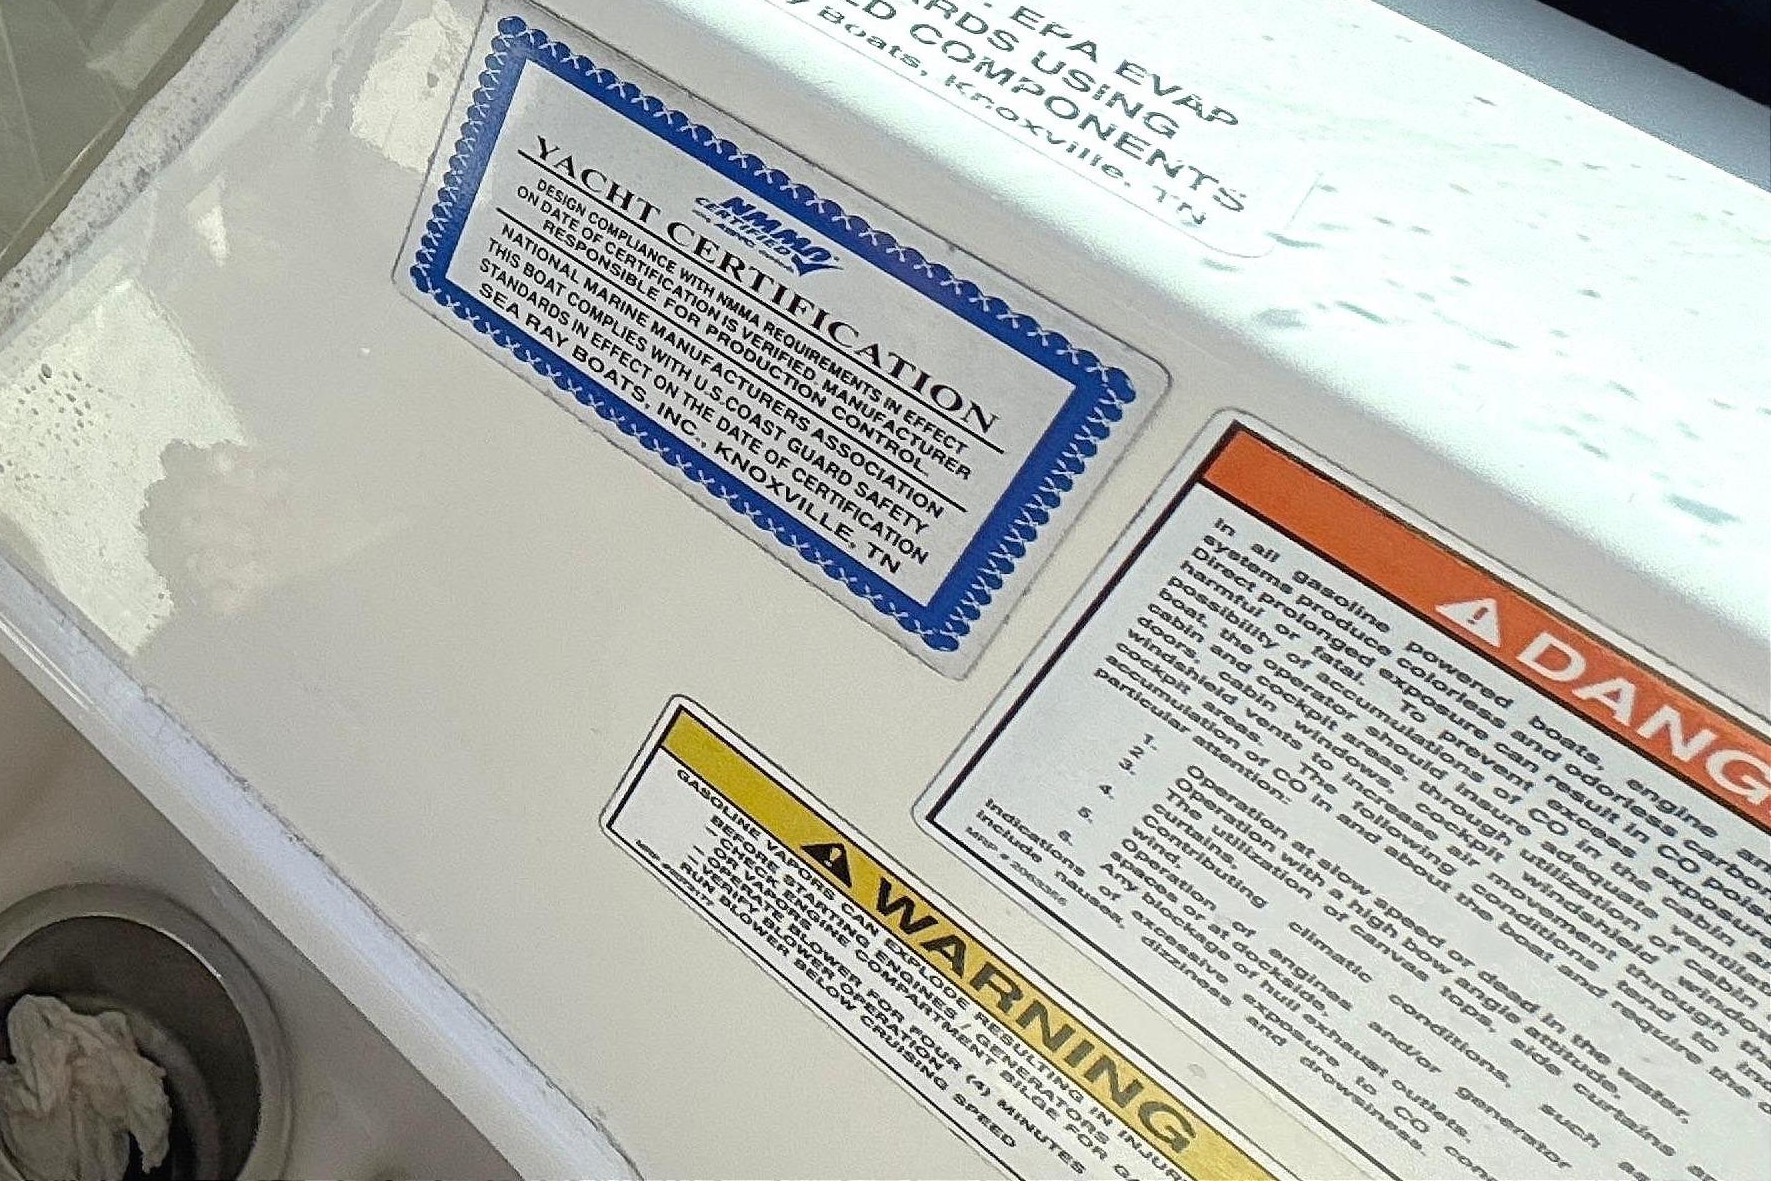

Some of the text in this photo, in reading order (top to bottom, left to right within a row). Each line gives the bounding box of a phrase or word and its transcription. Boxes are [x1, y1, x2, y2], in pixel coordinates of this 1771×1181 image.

[909, 23, 1247, 213] COMPONENTS
[1009, 5, 1097, 63] EPA
[1113, 59, 1239, 126] EVAP
[1031, 50, 1180, 140] USING
[501, 223, 945, 519] NATIONAL MARINE MANUFACTURERS ASSOCIATION
[517, 185, 540, 207] ON
[540, 200, 580, 232] DATE
[581, 227, 604, 243] OF
[604, 241, 721, 322] CERTIFICATION
[721, 315, 739, 333] IS
[822, 378, 972, 480] MANUFACTURER
[537, 135, 1000, 434] YACHT CERTIFICATION
[537, 178, 969, 454] DESIGN COMPLIANCE WITH NMMA REQUIREMENTS IN EFFECT
[542, 219, 660, 302] RESPONSIBLE
[663, 296, 701, 328] FOR
[705, 323, 827, 408] PRODUCTION
[694, 197, 792, 255] CERTIFIED
[479, 258, 929, 565] STANDARDS IN EFFECT ON THE DATE OF CERTIFICATION
[479, 282, 901, 574] SEA RAY BOATS, INC., KNOXVILLE, TN
[488, 237, 930, 535] THIS BOAT COMPLIES WITH U.S.COAST GUARD SAFETY
[1179, 560, 1637, 859] harmful or fatal. To prevent excess
[1191, 546, 1701, 874] Direct prolonged exposure can result in CO
[1201, 534, 1294, 595] systems
[1295, 594, 1393, 657] produce
[1396, 657, 1507, 729] colorless
[1510, 730, 1562, 763] and
[1564, 763, 1678, 838] odorless
[1212, 517, 1718, 838] In all gasoline powered boats, engine
[677, 769, 762, 841] GASOLINE
[766, 839, 836, 901] VAPORS
[841, 902, 880, 938] CAN
[883, 937, 970, 1011] EXPLODE
[973, 1011, 1084, 1104] RESULTING
[1089, 1107, 1113, 1127] IN
[875, 876, 1197, 1154] WARNING
[1186, 765, 1611, 1066] Operation at slow speed or dead in the
